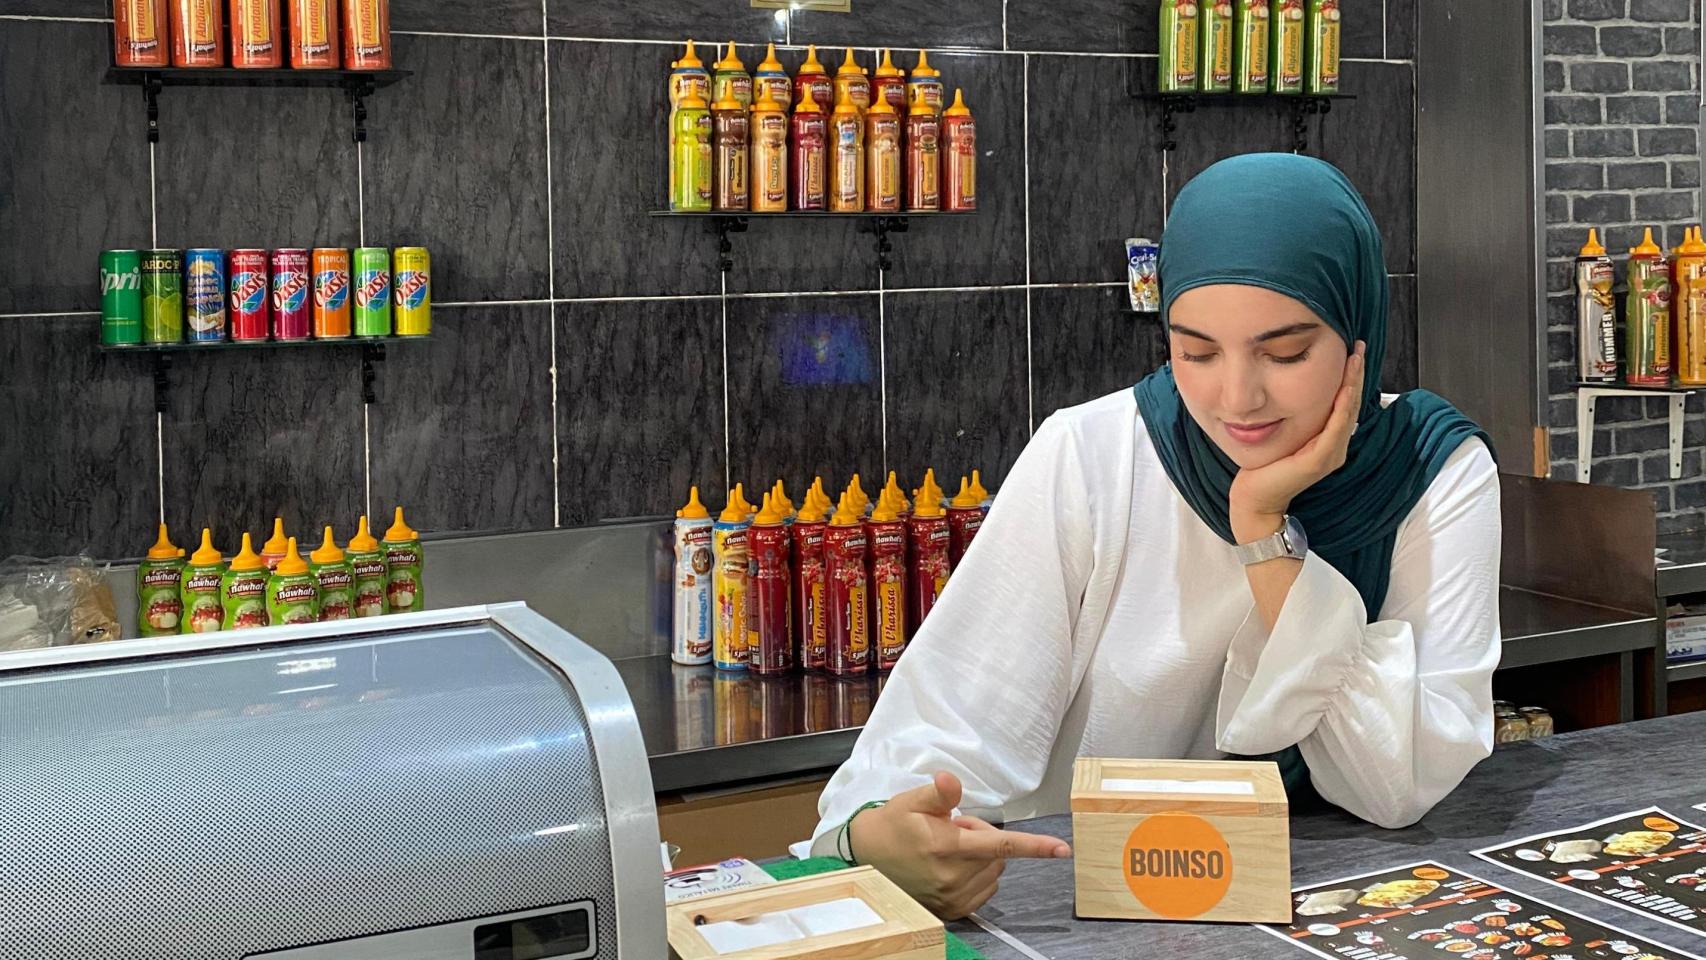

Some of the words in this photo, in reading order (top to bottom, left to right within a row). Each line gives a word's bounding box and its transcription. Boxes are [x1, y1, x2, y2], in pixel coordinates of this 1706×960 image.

[231, 272, 267, 312] Oasis
[273, 272, 308, 312] Oasis
[314, 270, 350, 308] Oasis
[355, 270, 391, 308] Oasis
[394, 270, 428, 308] Oasis
[1602, 313, 1616, 363] HUMMER
[145, 573, 181, 583] nawhal's
[388, 554, 416, 564] awhal's
[188, 578, 222, 589] nawhal's
[231, 581, 269, 594] nawhal's
[278, 587, 315, 600] nawhal's
[854, 591, 864, 645] L'harissa
[885, 587, 897, 641] L'harissa
[1130, 848, 1223, 879] BOINSO
